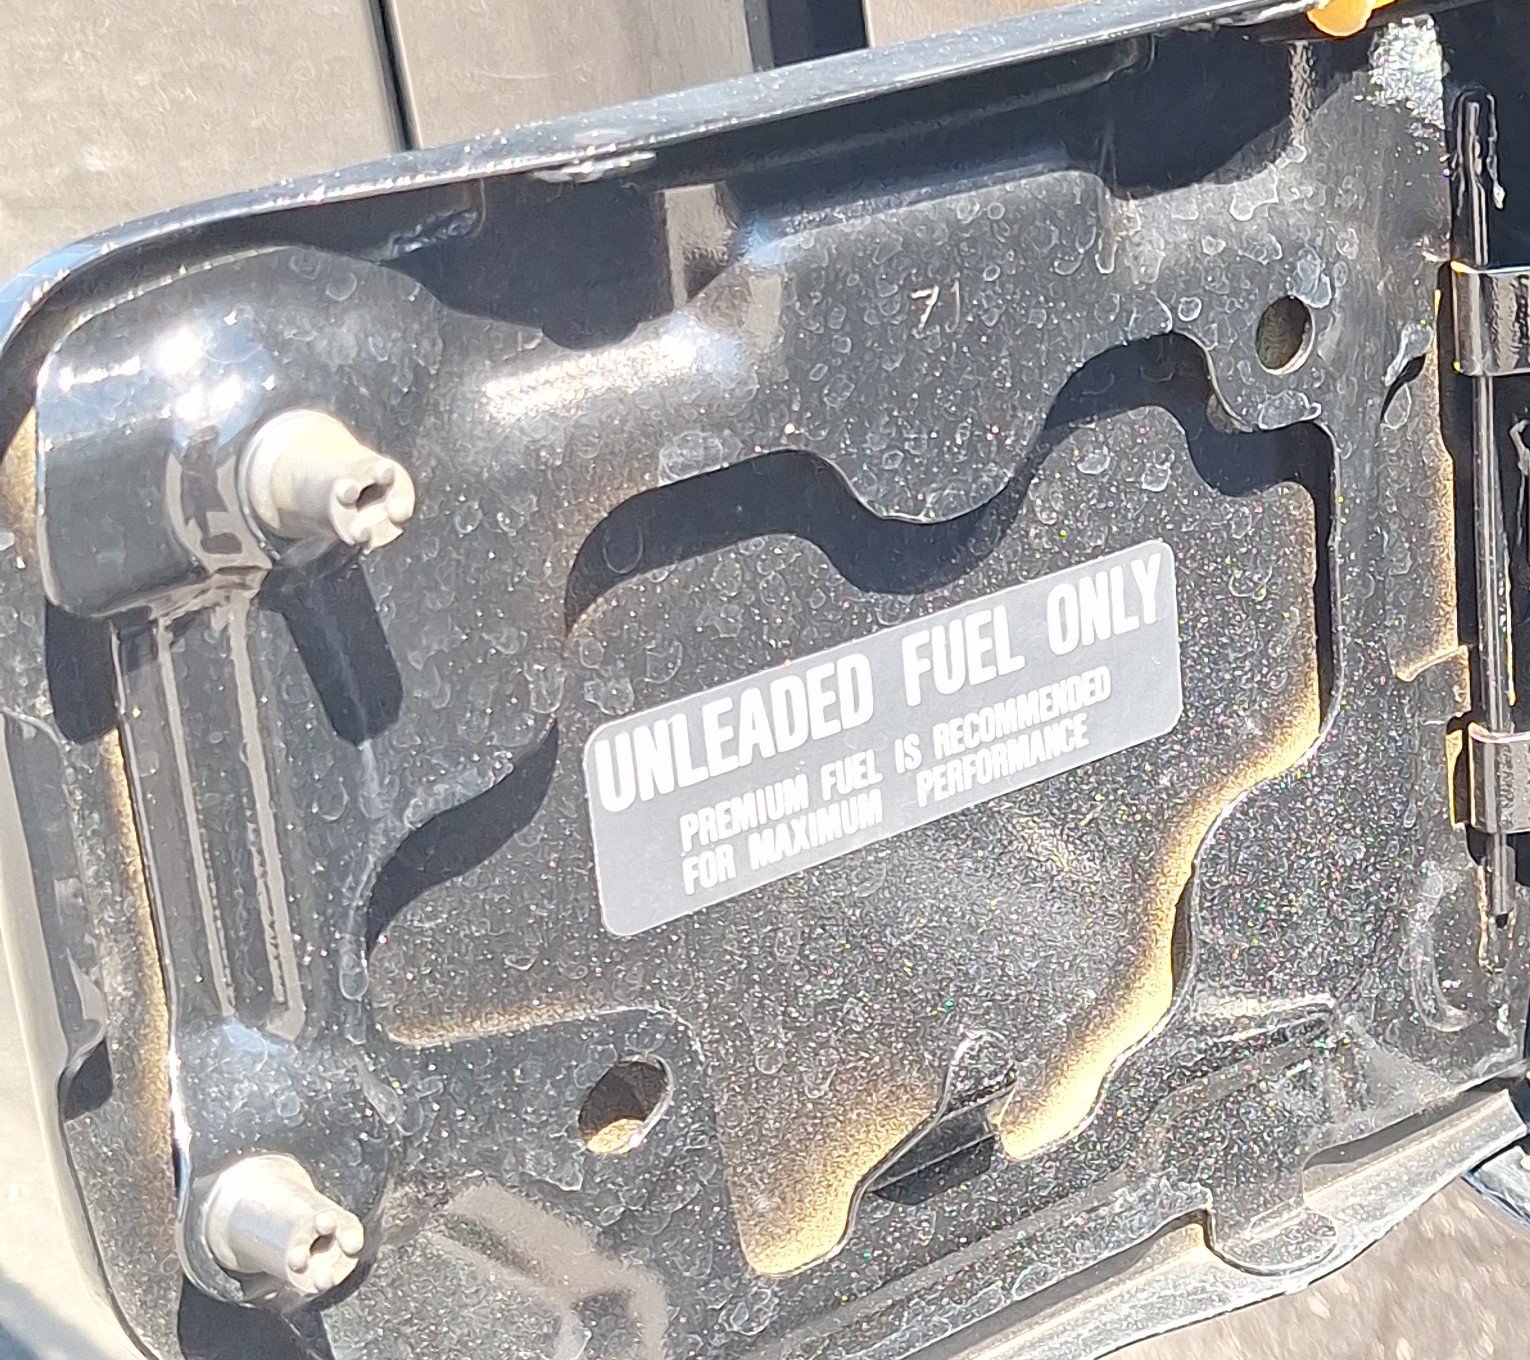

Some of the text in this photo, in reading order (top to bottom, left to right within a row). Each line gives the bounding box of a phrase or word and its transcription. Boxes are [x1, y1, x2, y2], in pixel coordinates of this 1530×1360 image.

[596, 553, 1163, 812] UNLEADED FUEL ONLY
[679, 666, 1112, 852] PREMIUM FUEL IS RECOMMENDED
[682, 713, 1089, 895] FOR MAXIMUM PERFORMANCE
